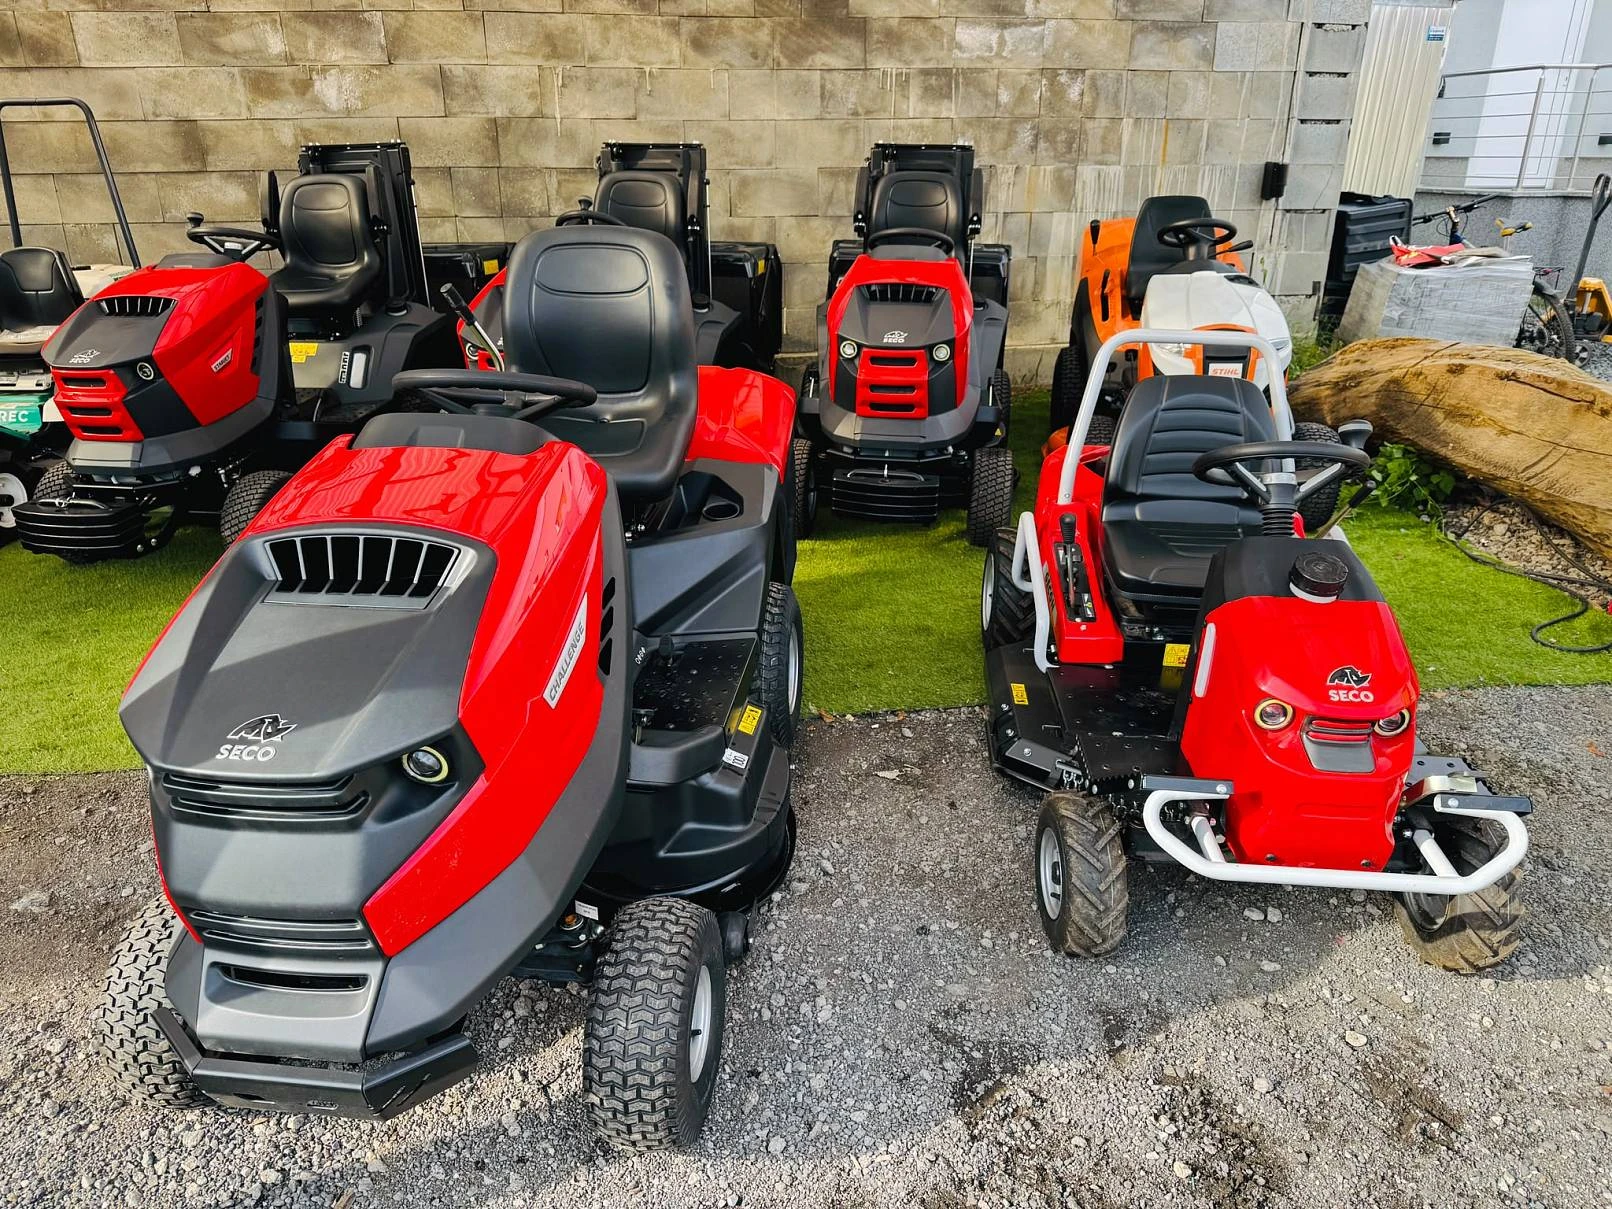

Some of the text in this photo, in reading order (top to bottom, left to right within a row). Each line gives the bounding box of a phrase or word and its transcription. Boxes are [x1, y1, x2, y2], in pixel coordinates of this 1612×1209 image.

[549, 621, 584, 701] CHALLENGE
[1328, 689, 1374, 703] SECO
[215, 744, 276, 761] SECO
